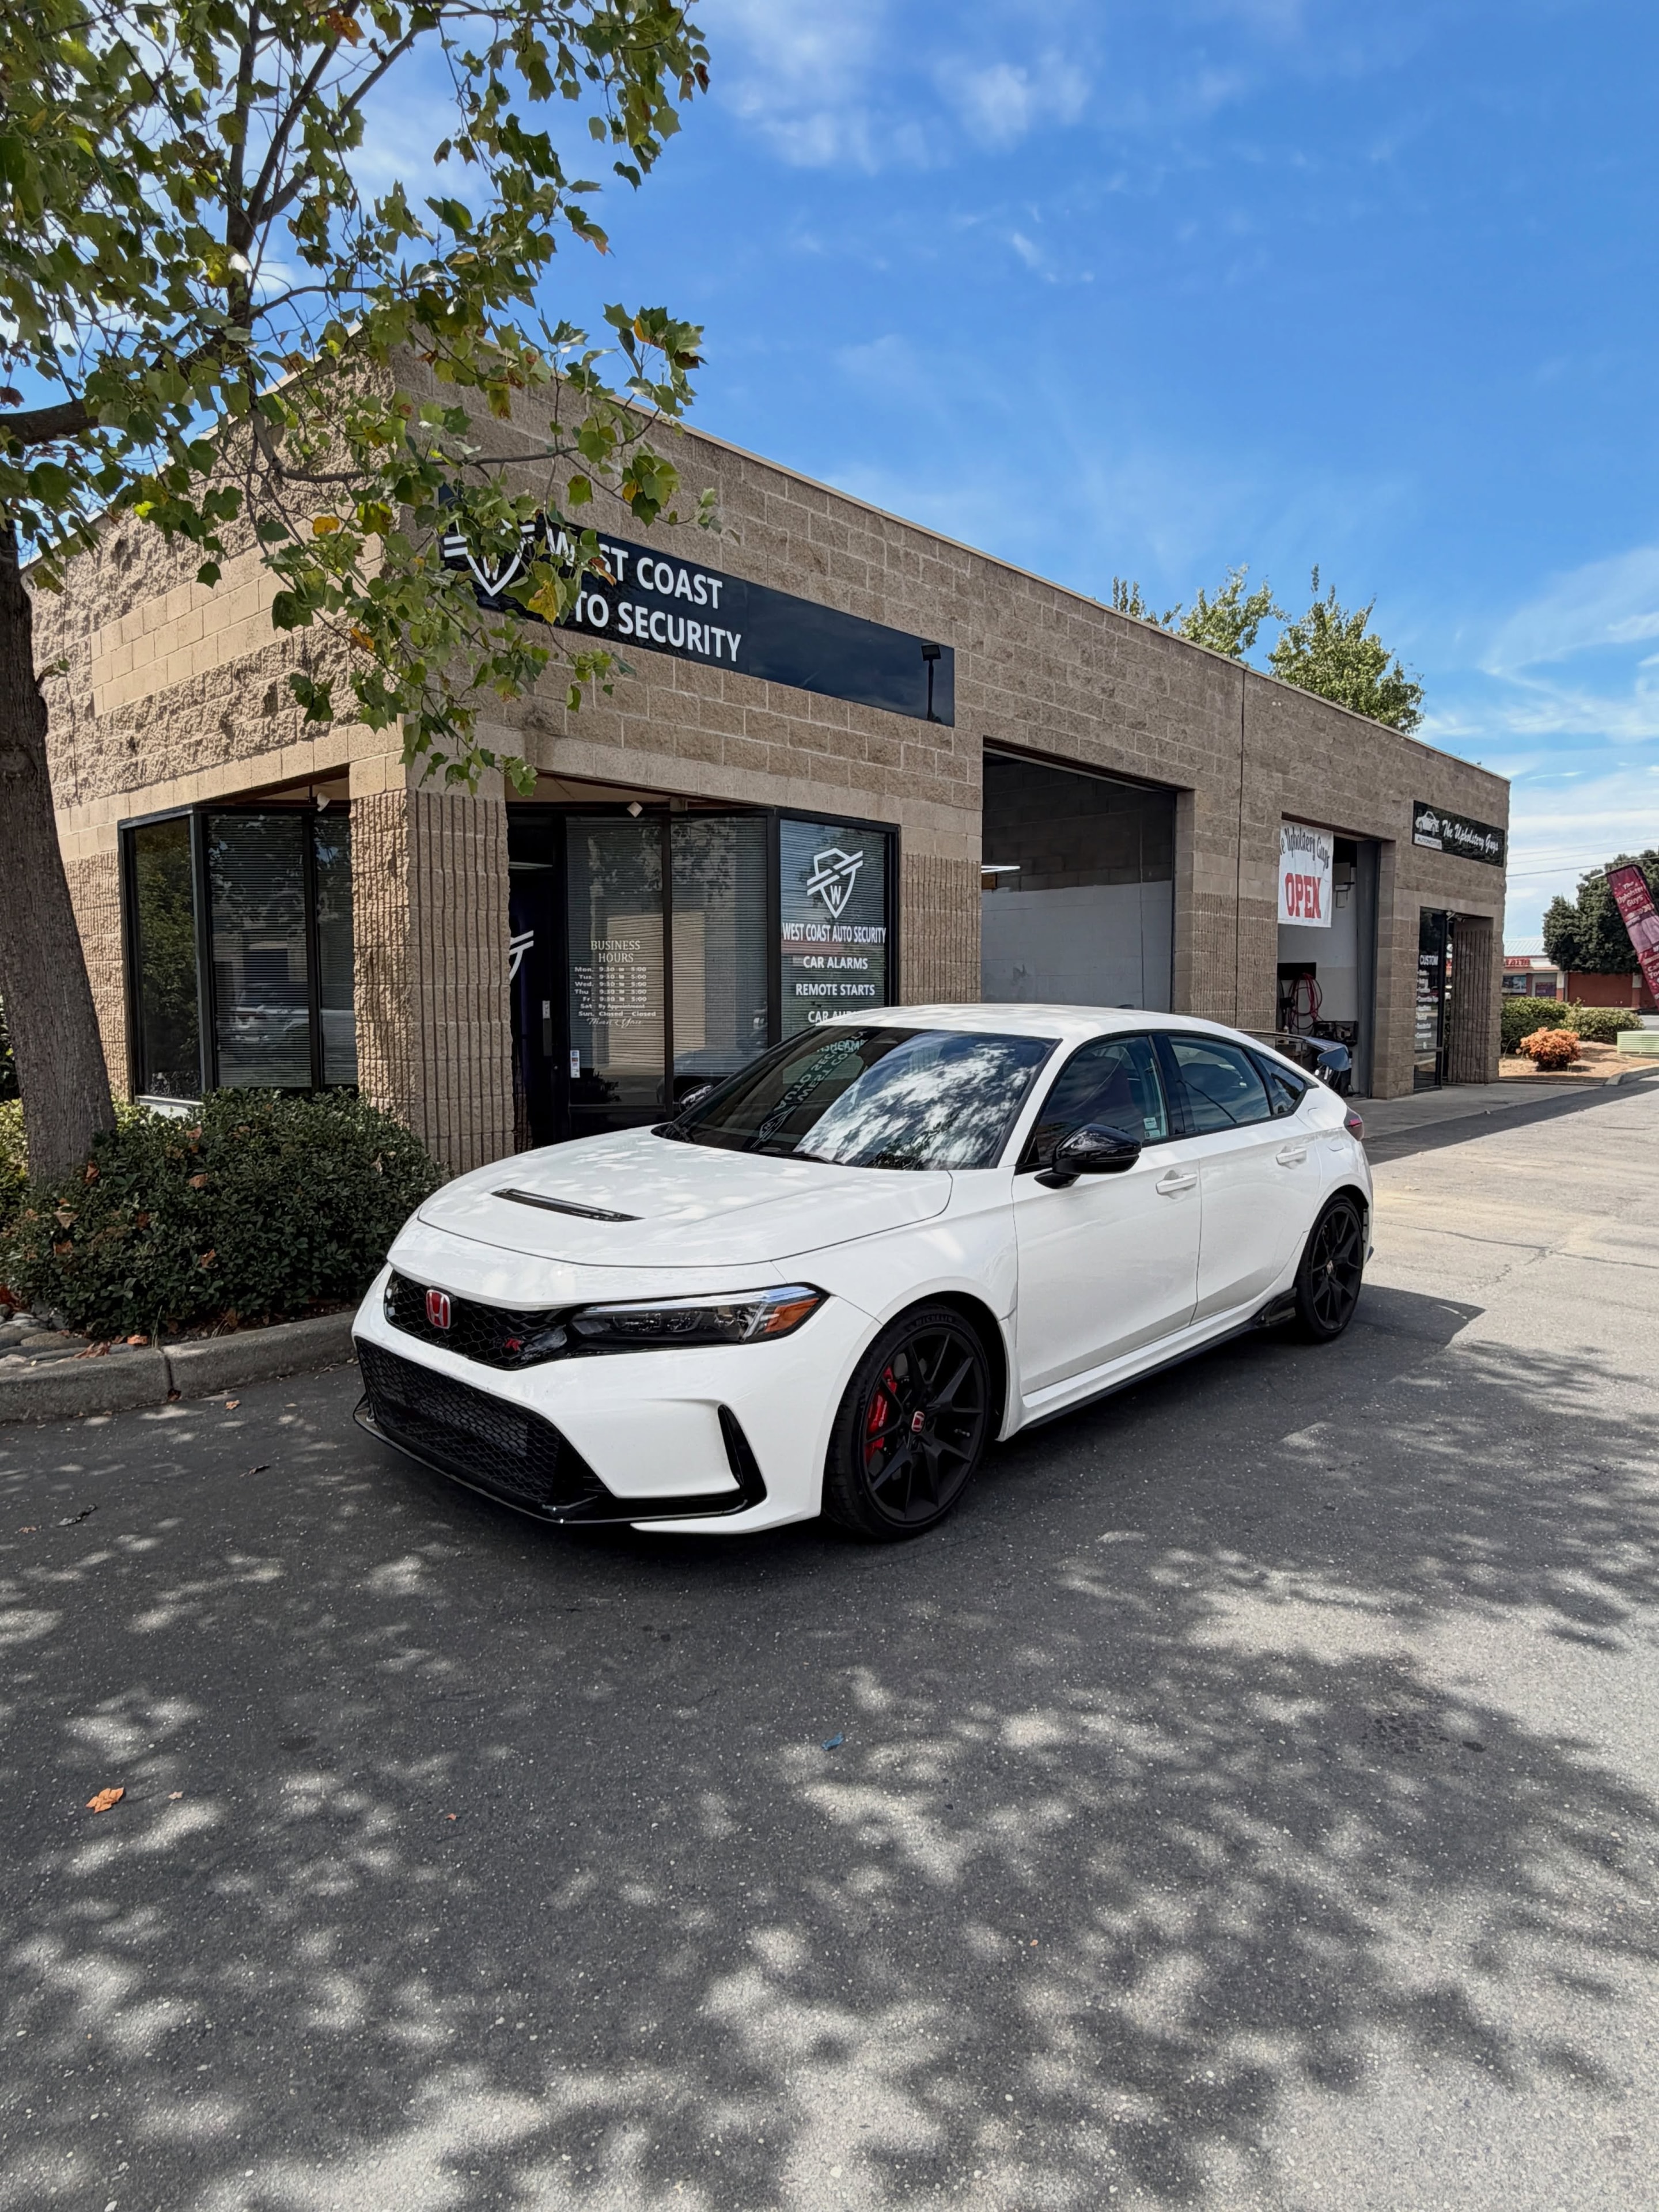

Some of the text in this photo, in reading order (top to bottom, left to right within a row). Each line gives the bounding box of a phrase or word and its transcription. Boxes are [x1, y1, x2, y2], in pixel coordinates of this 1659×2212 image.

[545, 527, 629, 582] WST
[637, 556, 724, 609] COAST
[618, 601, 743, 662] SECURITY
[1441, 819, 1453, 839] The
[1285, 826, 1316, 862] Upholstery
[1317, 836, 1331, 872] Guys
[1285, 872, 1321, 919] OPEN
[1626, 894, 1644, 907] Guys
[782, 922, 887, 944] WEST COAST AUTO SECURITY
[590, 940, 641, 951] BUSINESS
[598, 952, 634, 963] HOURS
[803, 956, 869, 970] CAR ALARMS
[796, 983, 876, 997] REMOTE STARTS
[808, 1010, 830, 1023] CAR
